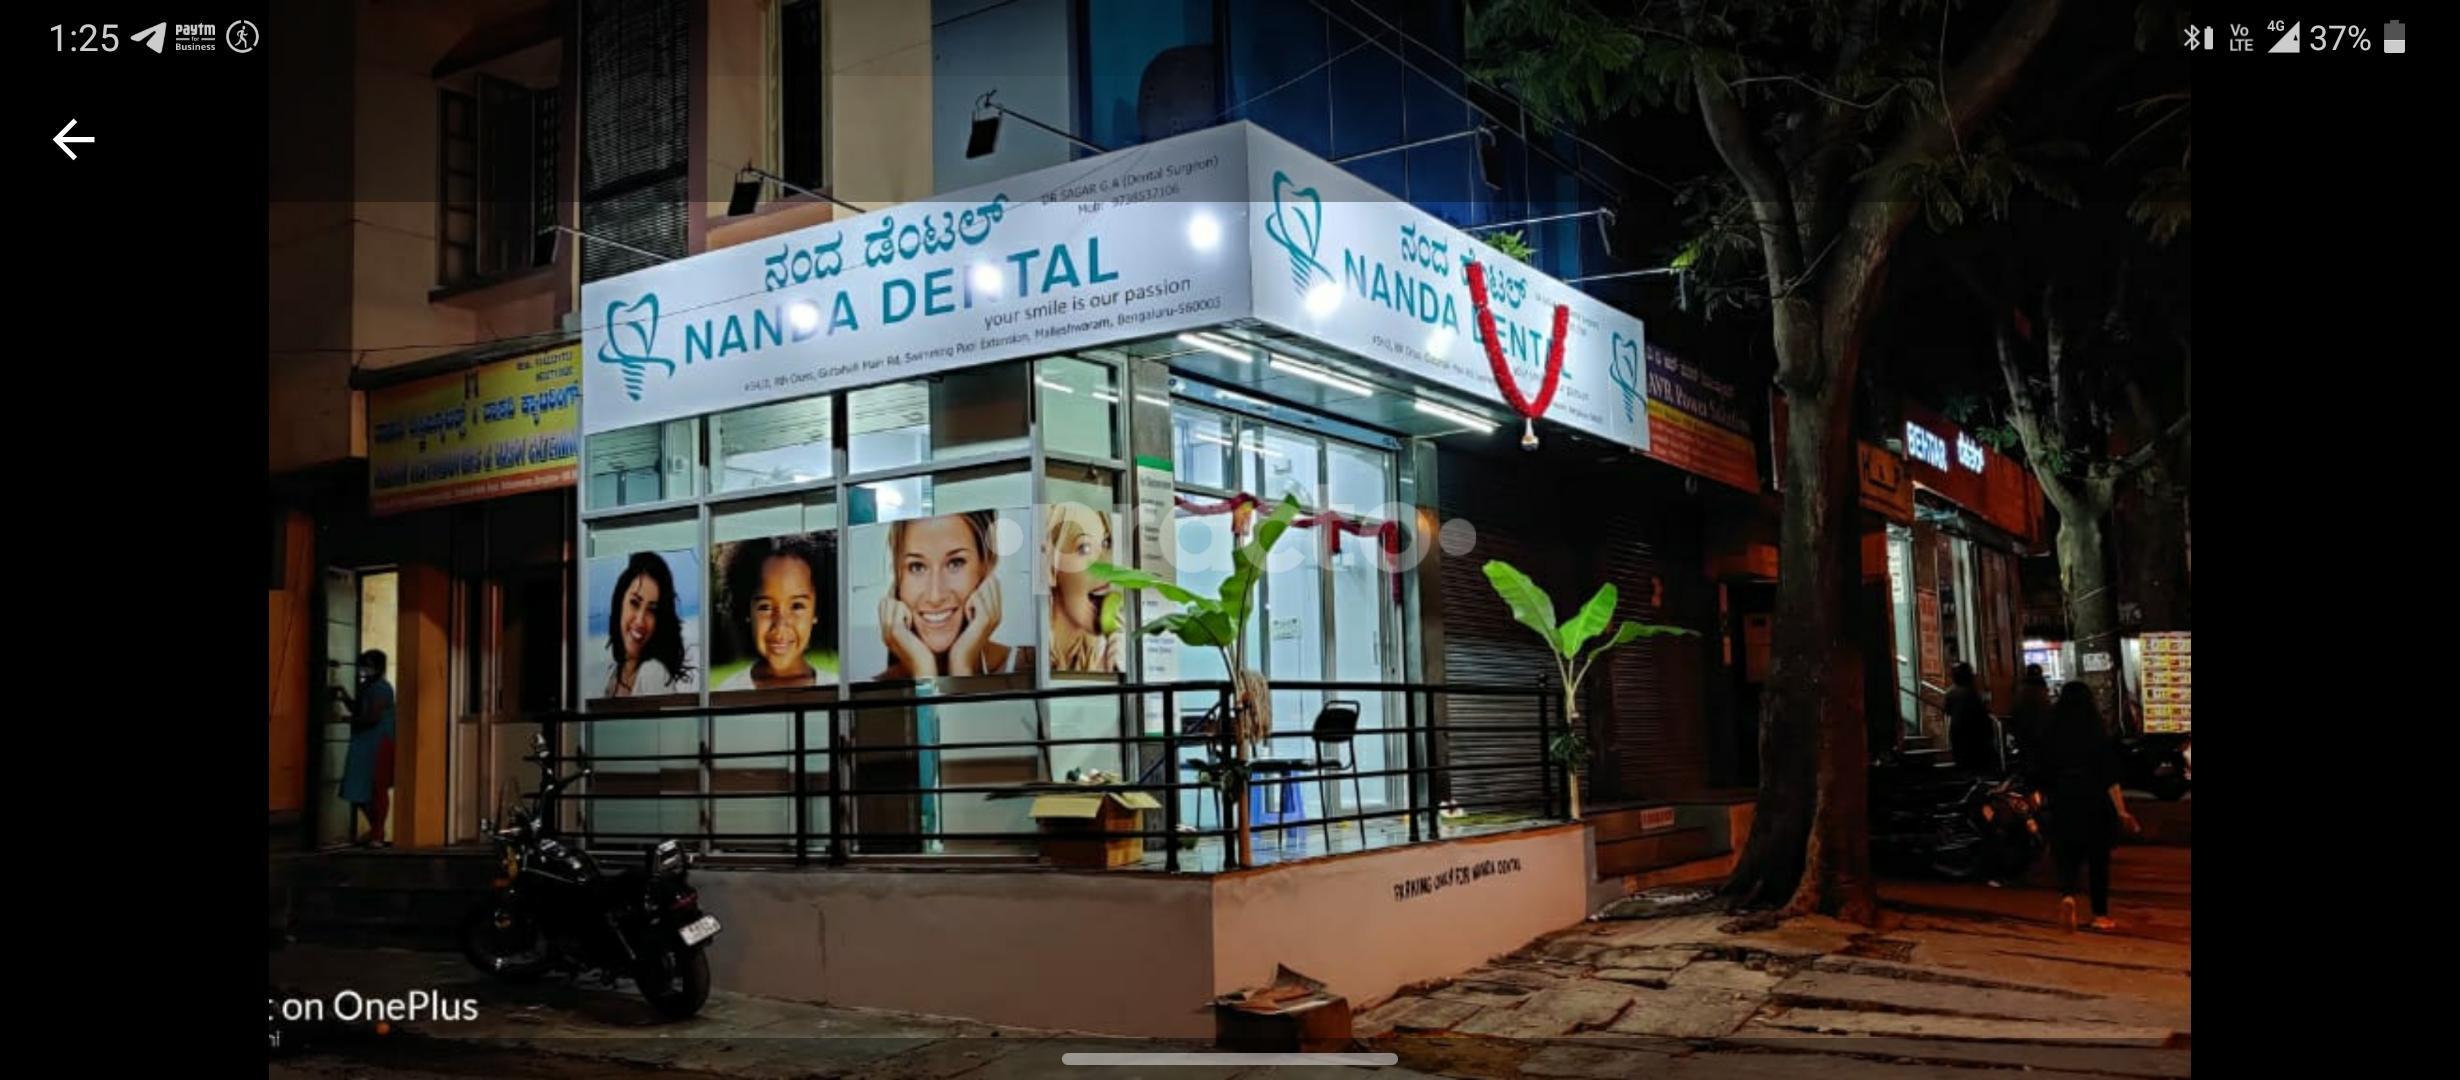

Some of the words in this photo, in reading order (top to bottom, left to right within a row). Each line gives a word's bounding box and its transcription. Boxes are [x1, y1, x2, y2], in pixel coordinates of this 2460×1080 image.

[765, 230, 843, 293] ನಂದ
[864, 193, 1010, 267] ಡೆಂಟಲ್
[1401, 222, 1449, 278] ನಂದ
[984, 310, 1020, 331] your
[1024, 300, 1067, 320] smile
[1072, 295, 1085, 312] is
[1089, 290, 1118, 308] our
[1125, 278, 1191, 306] passion
[1344, 247, 1460, 335] NANDA
